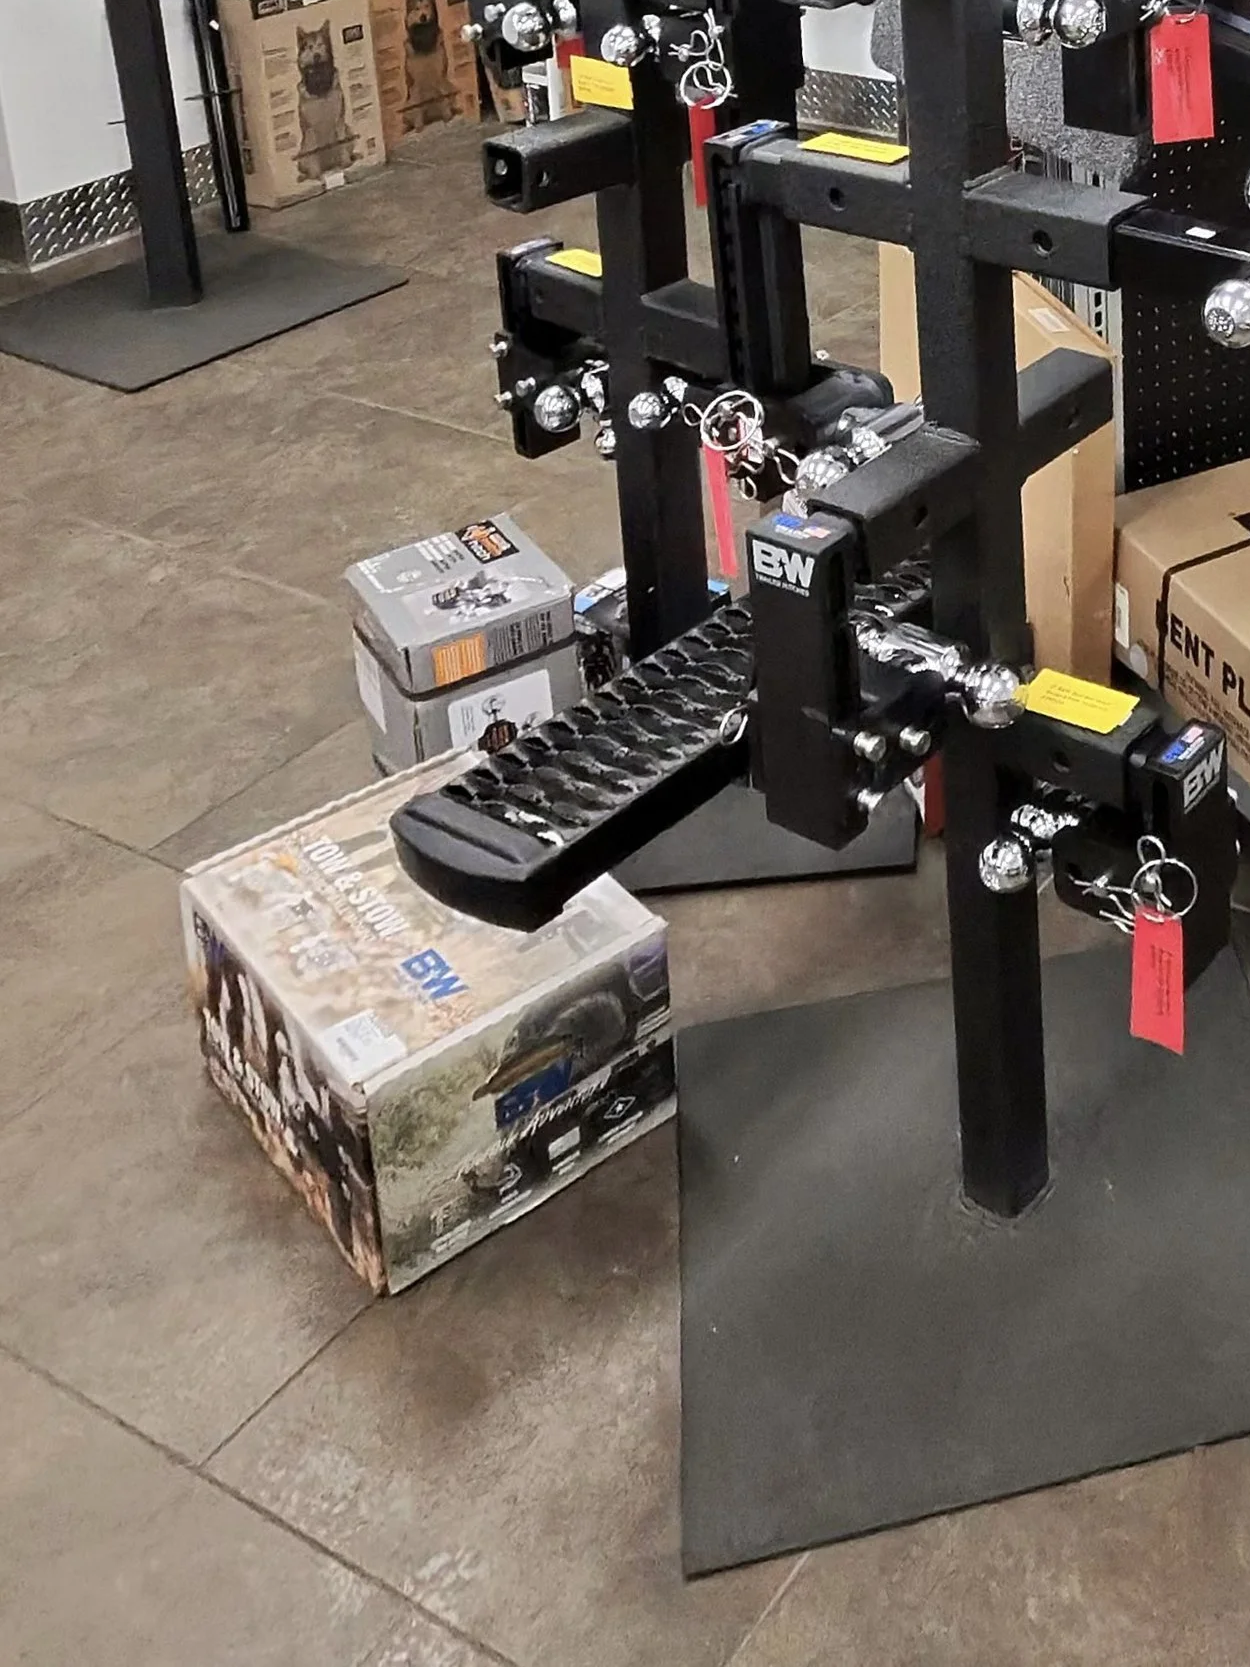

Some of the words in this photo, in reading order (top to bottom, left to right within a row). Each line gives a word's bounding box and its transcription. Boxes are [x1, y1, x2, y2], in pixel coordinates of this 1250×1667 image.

[303, 835, 350, 875] TOW
[333, 870, 363, 892] &
[348, 886, 411, 938] STOW
